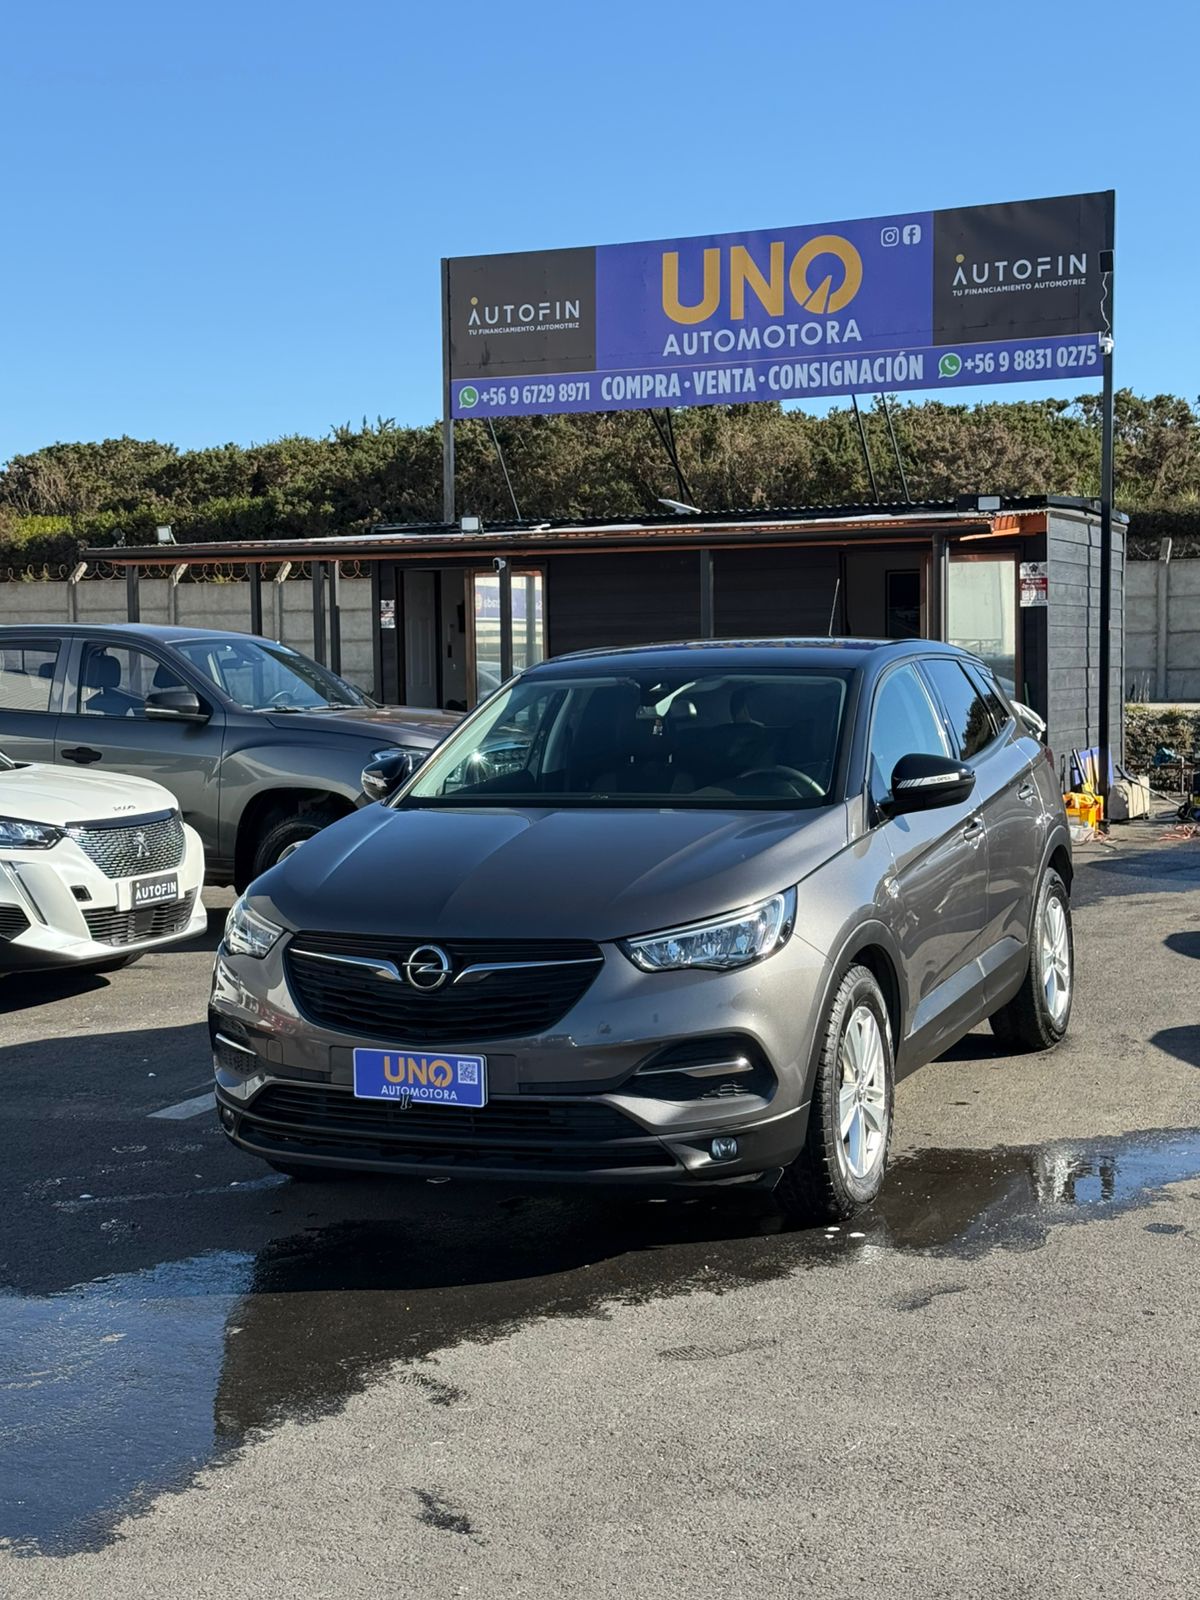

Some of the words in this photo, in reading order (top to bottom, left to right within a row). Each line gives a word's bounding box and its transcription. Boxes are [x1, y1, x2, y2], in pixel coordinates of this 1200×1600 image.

[662, 234, 863, 326] UNO
[952, 253, 1087, 287] AUTOFIN
[952, 289, 963, 297] TU
[964, 282, 1032, 296] FINANCIAMIENTO
[1033, 278, 1087, 289] AUTOMOTRIZ
[468, 297, 580, 326] AUTOFIN
[478, 325, 535, 335] FINANCIAMIENTO
[536, 322, 580, 331] AUTOMOTRIZ
[662, 319, 863, 357] AUTOMOTORA
[964, 352, 995, 374] +56
[999, 351, 1009, 373] 9
[1013, 347, 1053, 370] 8831
[1056, 344, 1097, 367] 0275
[601, 372, 682, 402] COMPRA
[692, 367, 757, 396] VENTA
[768, 351, 924, 391] CONSIGNACIÓN
[481, 386, 507, 406] +56
[510, 386, 519, 405] 9
[522, 383, 556, 404] 6729
[558, 381, 590, 402] 8971
[135, 882, 177, 900] AUTOFIN
[384, 1055, 454, 1088] UNO
[381, 1085, 458, 1101] AUTOMOTORA
